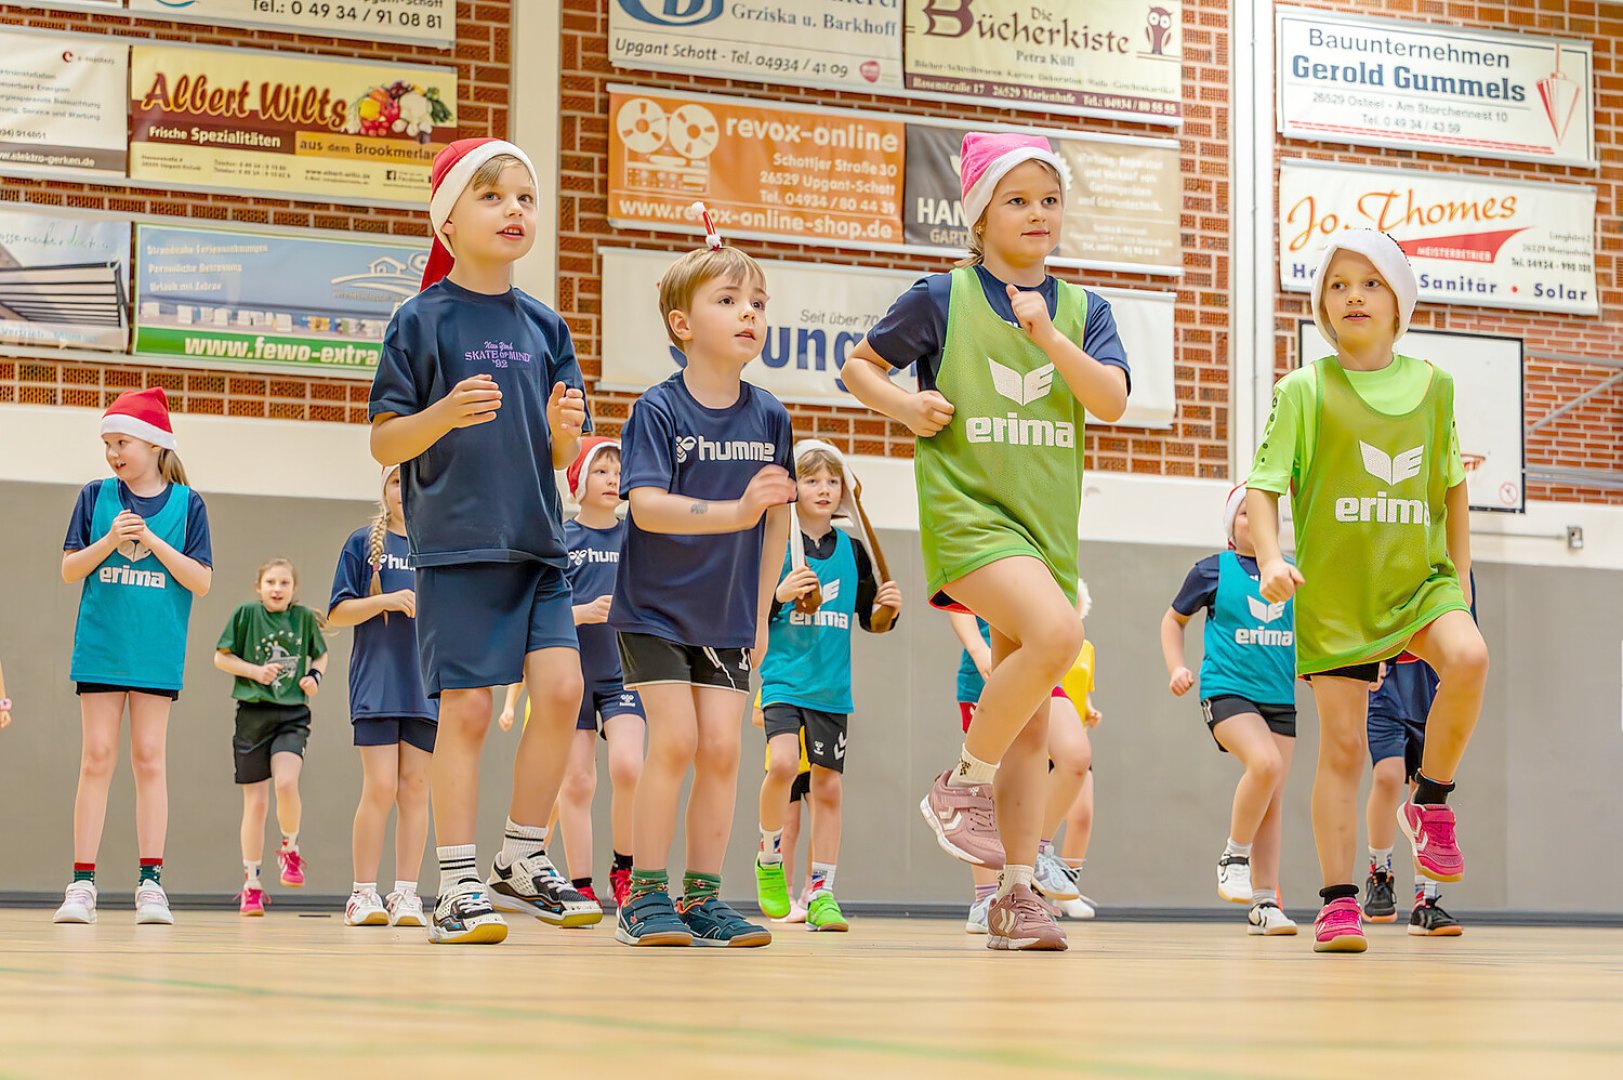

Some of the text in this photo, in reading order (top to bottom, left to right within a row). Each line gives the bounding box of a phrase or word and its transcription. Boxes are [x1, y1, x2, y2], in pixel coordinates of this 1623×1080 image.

[252, 0, 442, 29] Tel.: 0 49 34 / 91 08 81
[732, 3, 897, 36] Grziska u. Barkhoff
[1031, 6, 1053, 21] Die
[922, 0, 1129, 54] Bücherkiste
[615, 37, 668, 57] Upgant
[673, 44, 717, 61] Schott
[731, 50, 752, 65] Tel.
[755, 55, 799, 72] 04934
[803, 59, 810, 71] /
[830, 64, 848, 78] 09
[1016, 50, 1075, 67] Petra Küll
[1309, 28, 1510, 68] Bauunternehmen
[1292, 54, 1526, 102] Gerold Gummels
[141, 72, 347, 131] Albert Wilts
[1396, 103, 1415, 112] Am
[149, 126, 281, 147] Frische Spezialitäten
[300, 139, 323, 151] aus
[328, 143, 350, 153] dem
[725, 116, 899, 152] revox-online
[773, 152, 897, 177] Schottjer Straße 30
[760, 171, 896, 196] 26529 Upgant-Schott
[760, 189, 780, 204] Tel.
[784, 192, 828, 207] 04934
[859, 199, 877, 213] 44
[619, 199, 893, 240] www.reox-online-shop.de
[1287, 188, 1518, 252] Jo. Thomes
[1420, 274, 1497, 293] Sanitär
[1534, 283, 1588, 300] Solar
[800, 309, 825, 324] Seit
[829, 312, 860, 326] über
[185, 336, 379, 366] www.fewo-extra
[465, 350, 499, 361] SKATE
[966, 412, 1074, 449] erima
[100, 565, 166, 589] erima
[1235, 626, 1293, 646] erima
